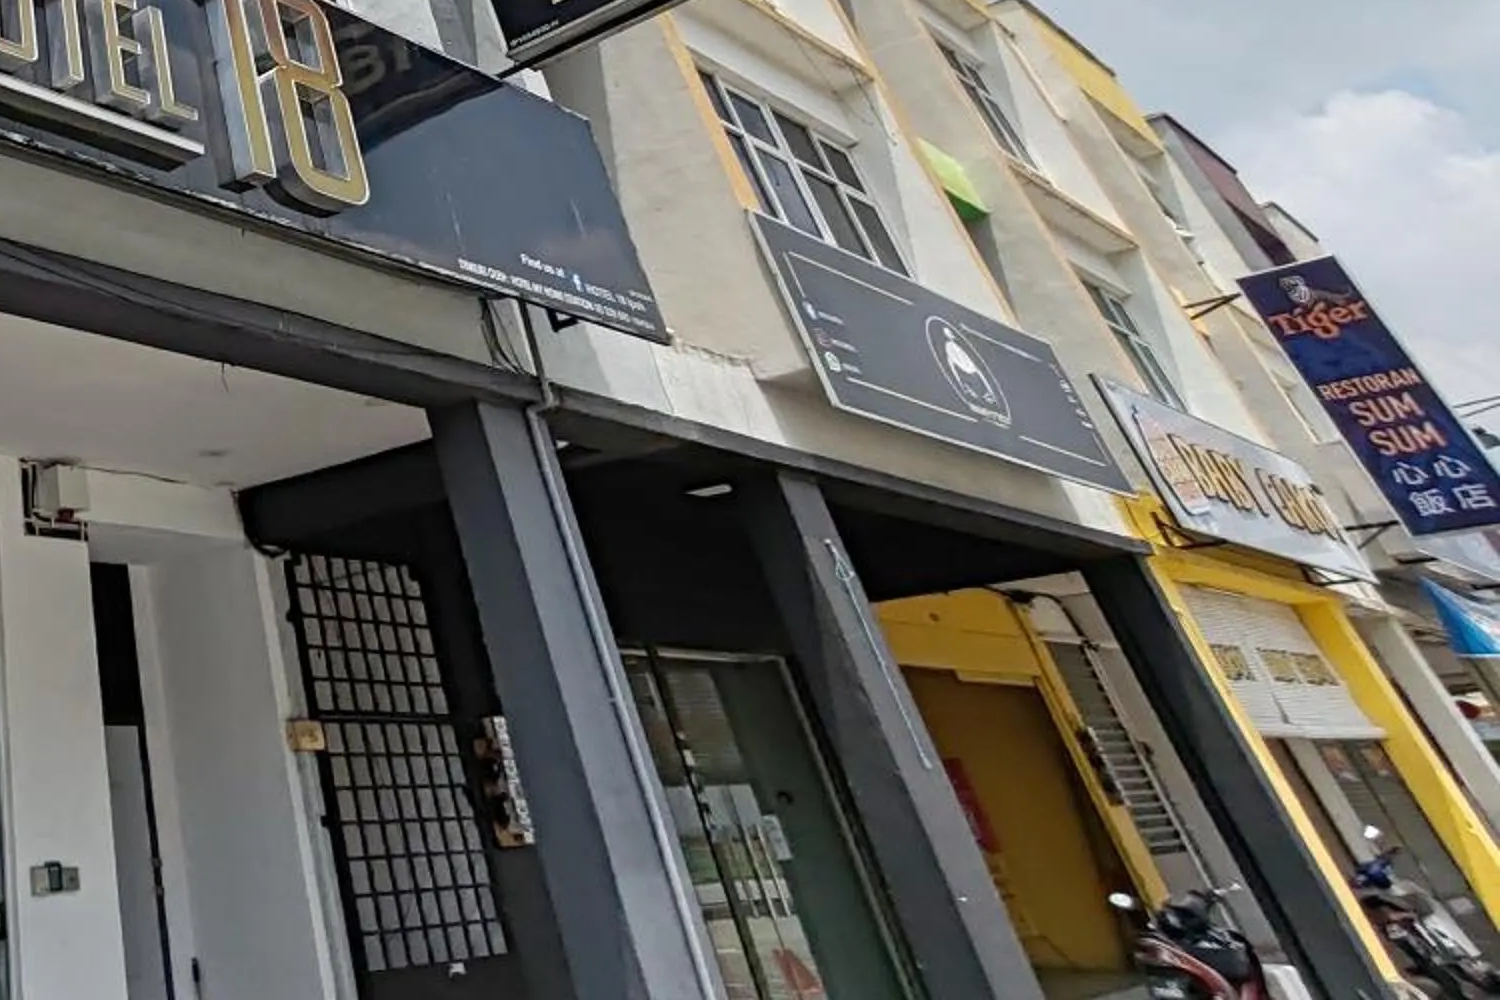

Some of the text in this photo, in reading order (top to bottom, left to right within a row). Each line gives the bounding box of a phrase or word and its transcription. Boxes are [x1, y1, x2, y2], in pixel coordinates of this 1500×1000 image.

[1268, 299, 1368, 339] Tiger
[1316, 367, 1423, 401] RESTORAN
[1349, 391, 1426, 427] SUM
[1369, 421, 1449, 456] SUM
[1392, 455, 1472, 486] 心心
[1408, 482, 1498, 518] 飯店
